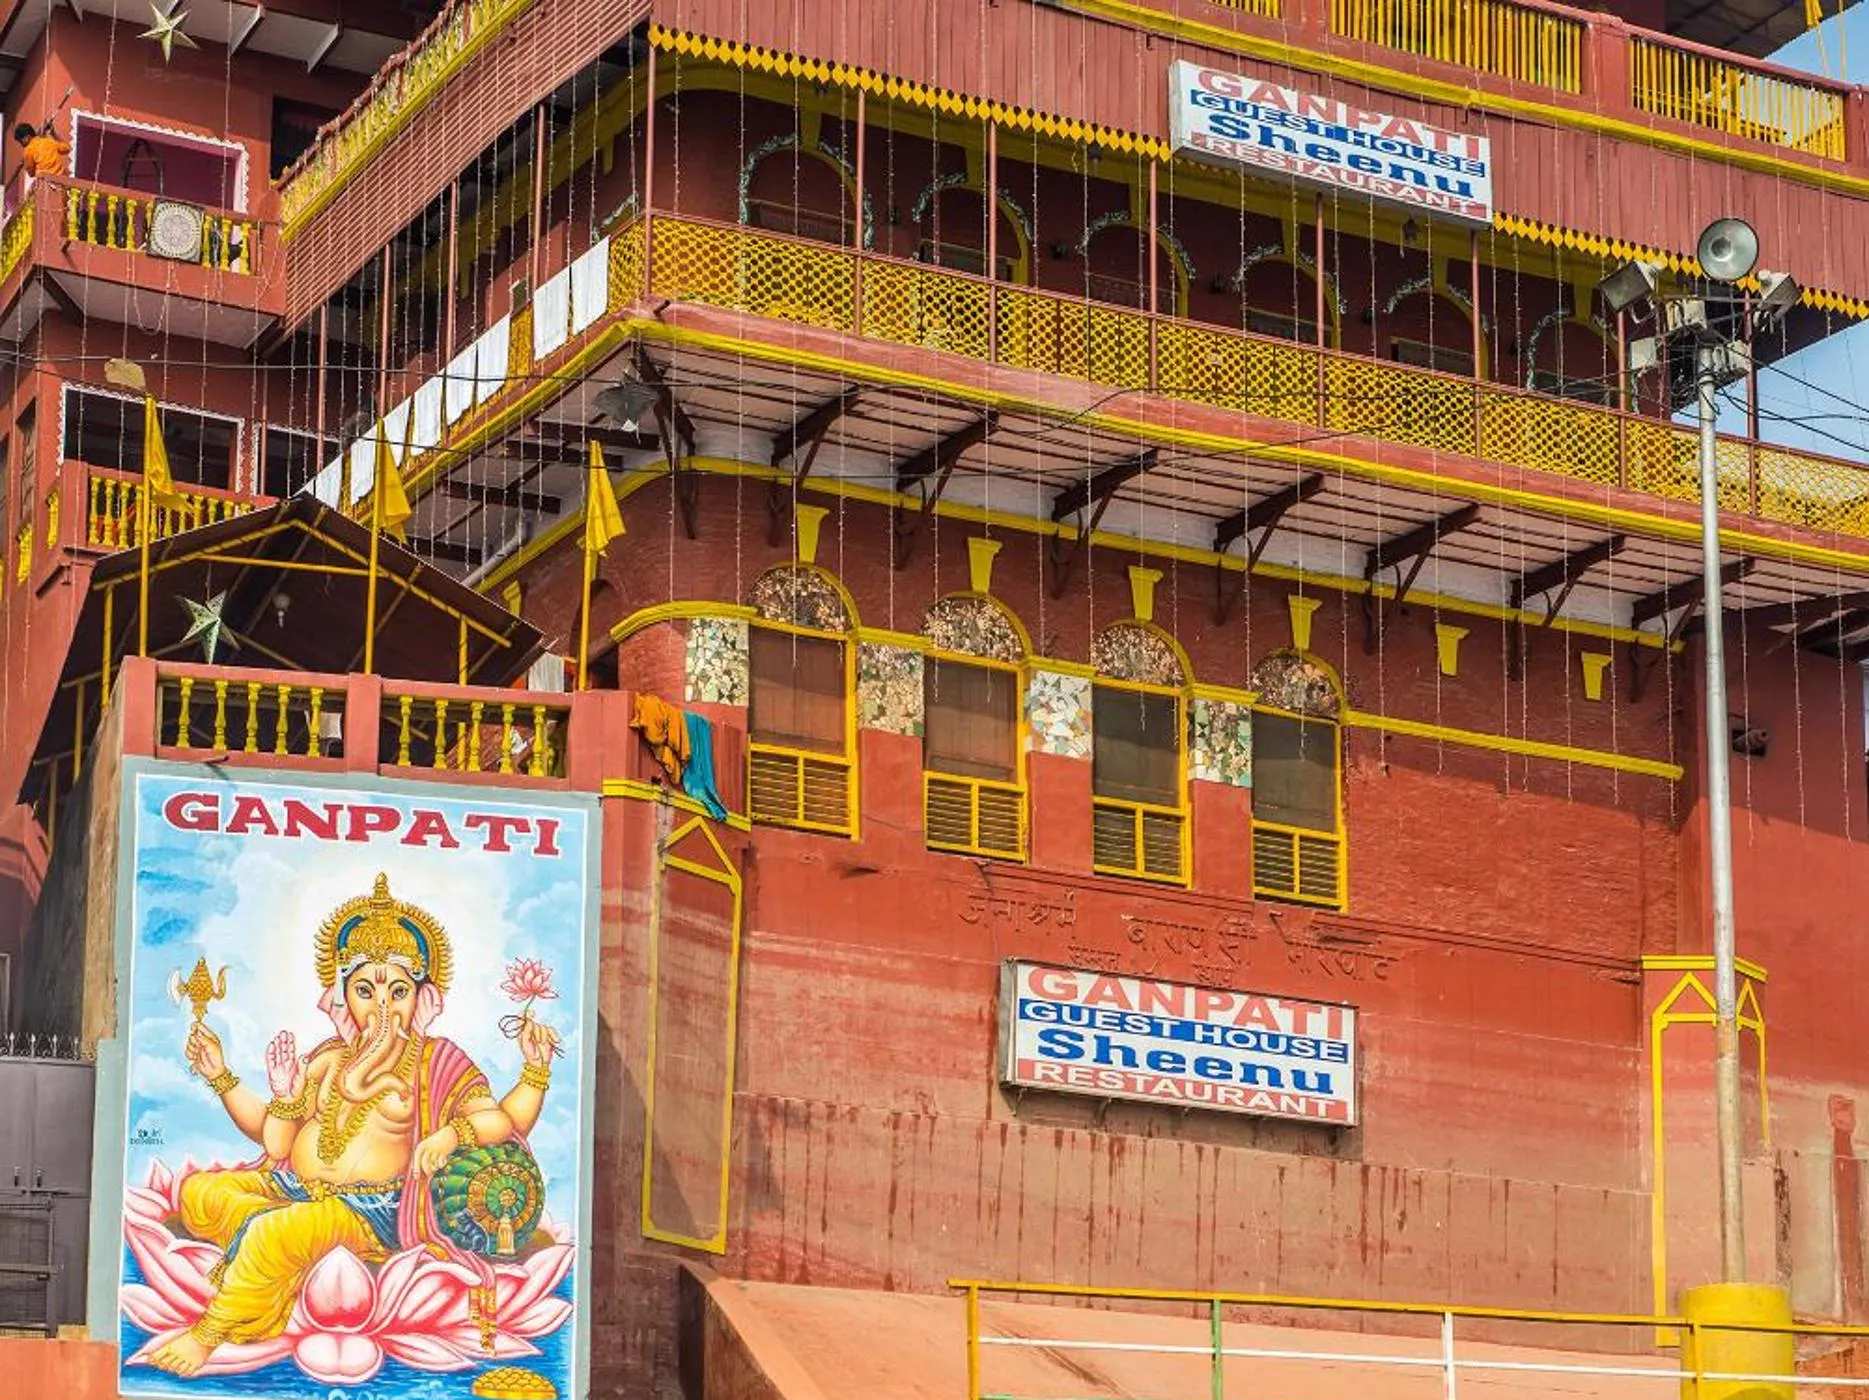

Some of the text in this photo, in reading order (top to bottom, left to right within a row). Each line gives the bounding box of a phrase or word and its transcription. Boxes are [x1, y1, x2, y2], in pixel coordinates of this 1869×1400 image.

[1195, 91, 1483, 176] GUEST HOUSE
[1199, 69, 1480, 160] GANPATI
[1204, 136, 1478, 214] RESTAURANT
[1208, 113, 1474, 199] Sheenu
[164, 792, 560, 856] GANPATI
[1024, 1001, 1346, 1062] GUEST HOUSE
[1027, 967, 1345, 1040] GANPATI
[1033, 1061, 1336, 1118] RESTAURANT
[1037, 1027, 1334, 1095] Sheenu
